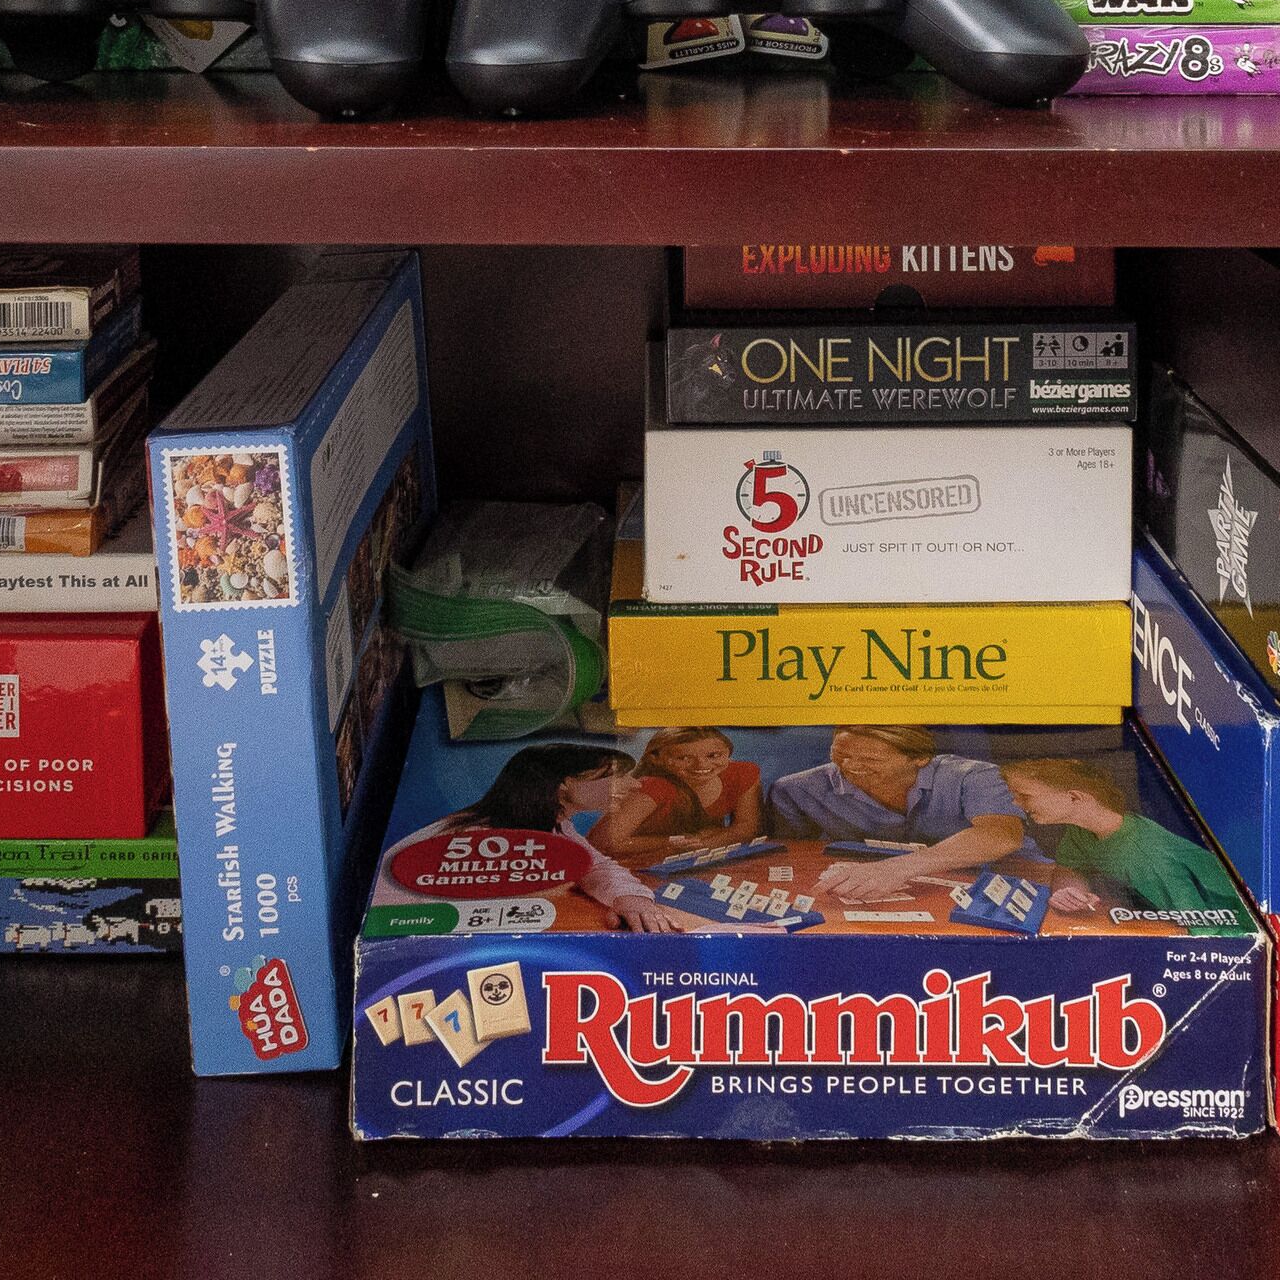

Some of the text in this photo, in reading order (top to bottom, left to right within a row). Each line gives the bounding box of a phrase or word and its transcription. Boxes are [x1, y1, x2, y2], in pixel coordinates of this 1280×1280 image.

[32, 357, 53, 375] 54
[740, 337, 1019, 384] ONE NIGHT
[743, 387, 1018, 411] ULTIMATE WEREWOLF
[1032, 405, 1129, 415] www.beziergames.com
[829, 482, 973, 518] UNCENSORED
[722, 525, 824, 560] SECOND
[841, 541, 1025, 554] JUST SPIT IT OUT! OR NOT...
[59, 573, 98, 589] This
[101, 576, 121, 589] at
[125, 573, 149, 589] All
[258, 627, 275, 696] PUZZLE
[716, 628, 1008, 701] Play Nine
[5, 758, 32, 772] OF
[37, 758, 95, 772] POOR
[38, 843, 90, 860] Trail
[98, 851, 136, 861] CARD
[141, 851, 178, 861] GAME
[446, 836, 546, 860] 50+
[437, 858, 547, 873] MILLION
[416, 869, 566, 888] Games Sold
[1166, 951, 1252, 967] For 2-4 Players
[642, 972, 758, 987] THE ORIGINAL
[1163, 969, 1251, 983] Ages 8 to Adult
[541, 969, 1167, 1107] Rummikub
[710, 1075, 1087, 1096] BRINGS PEOPLE TOGETHER
